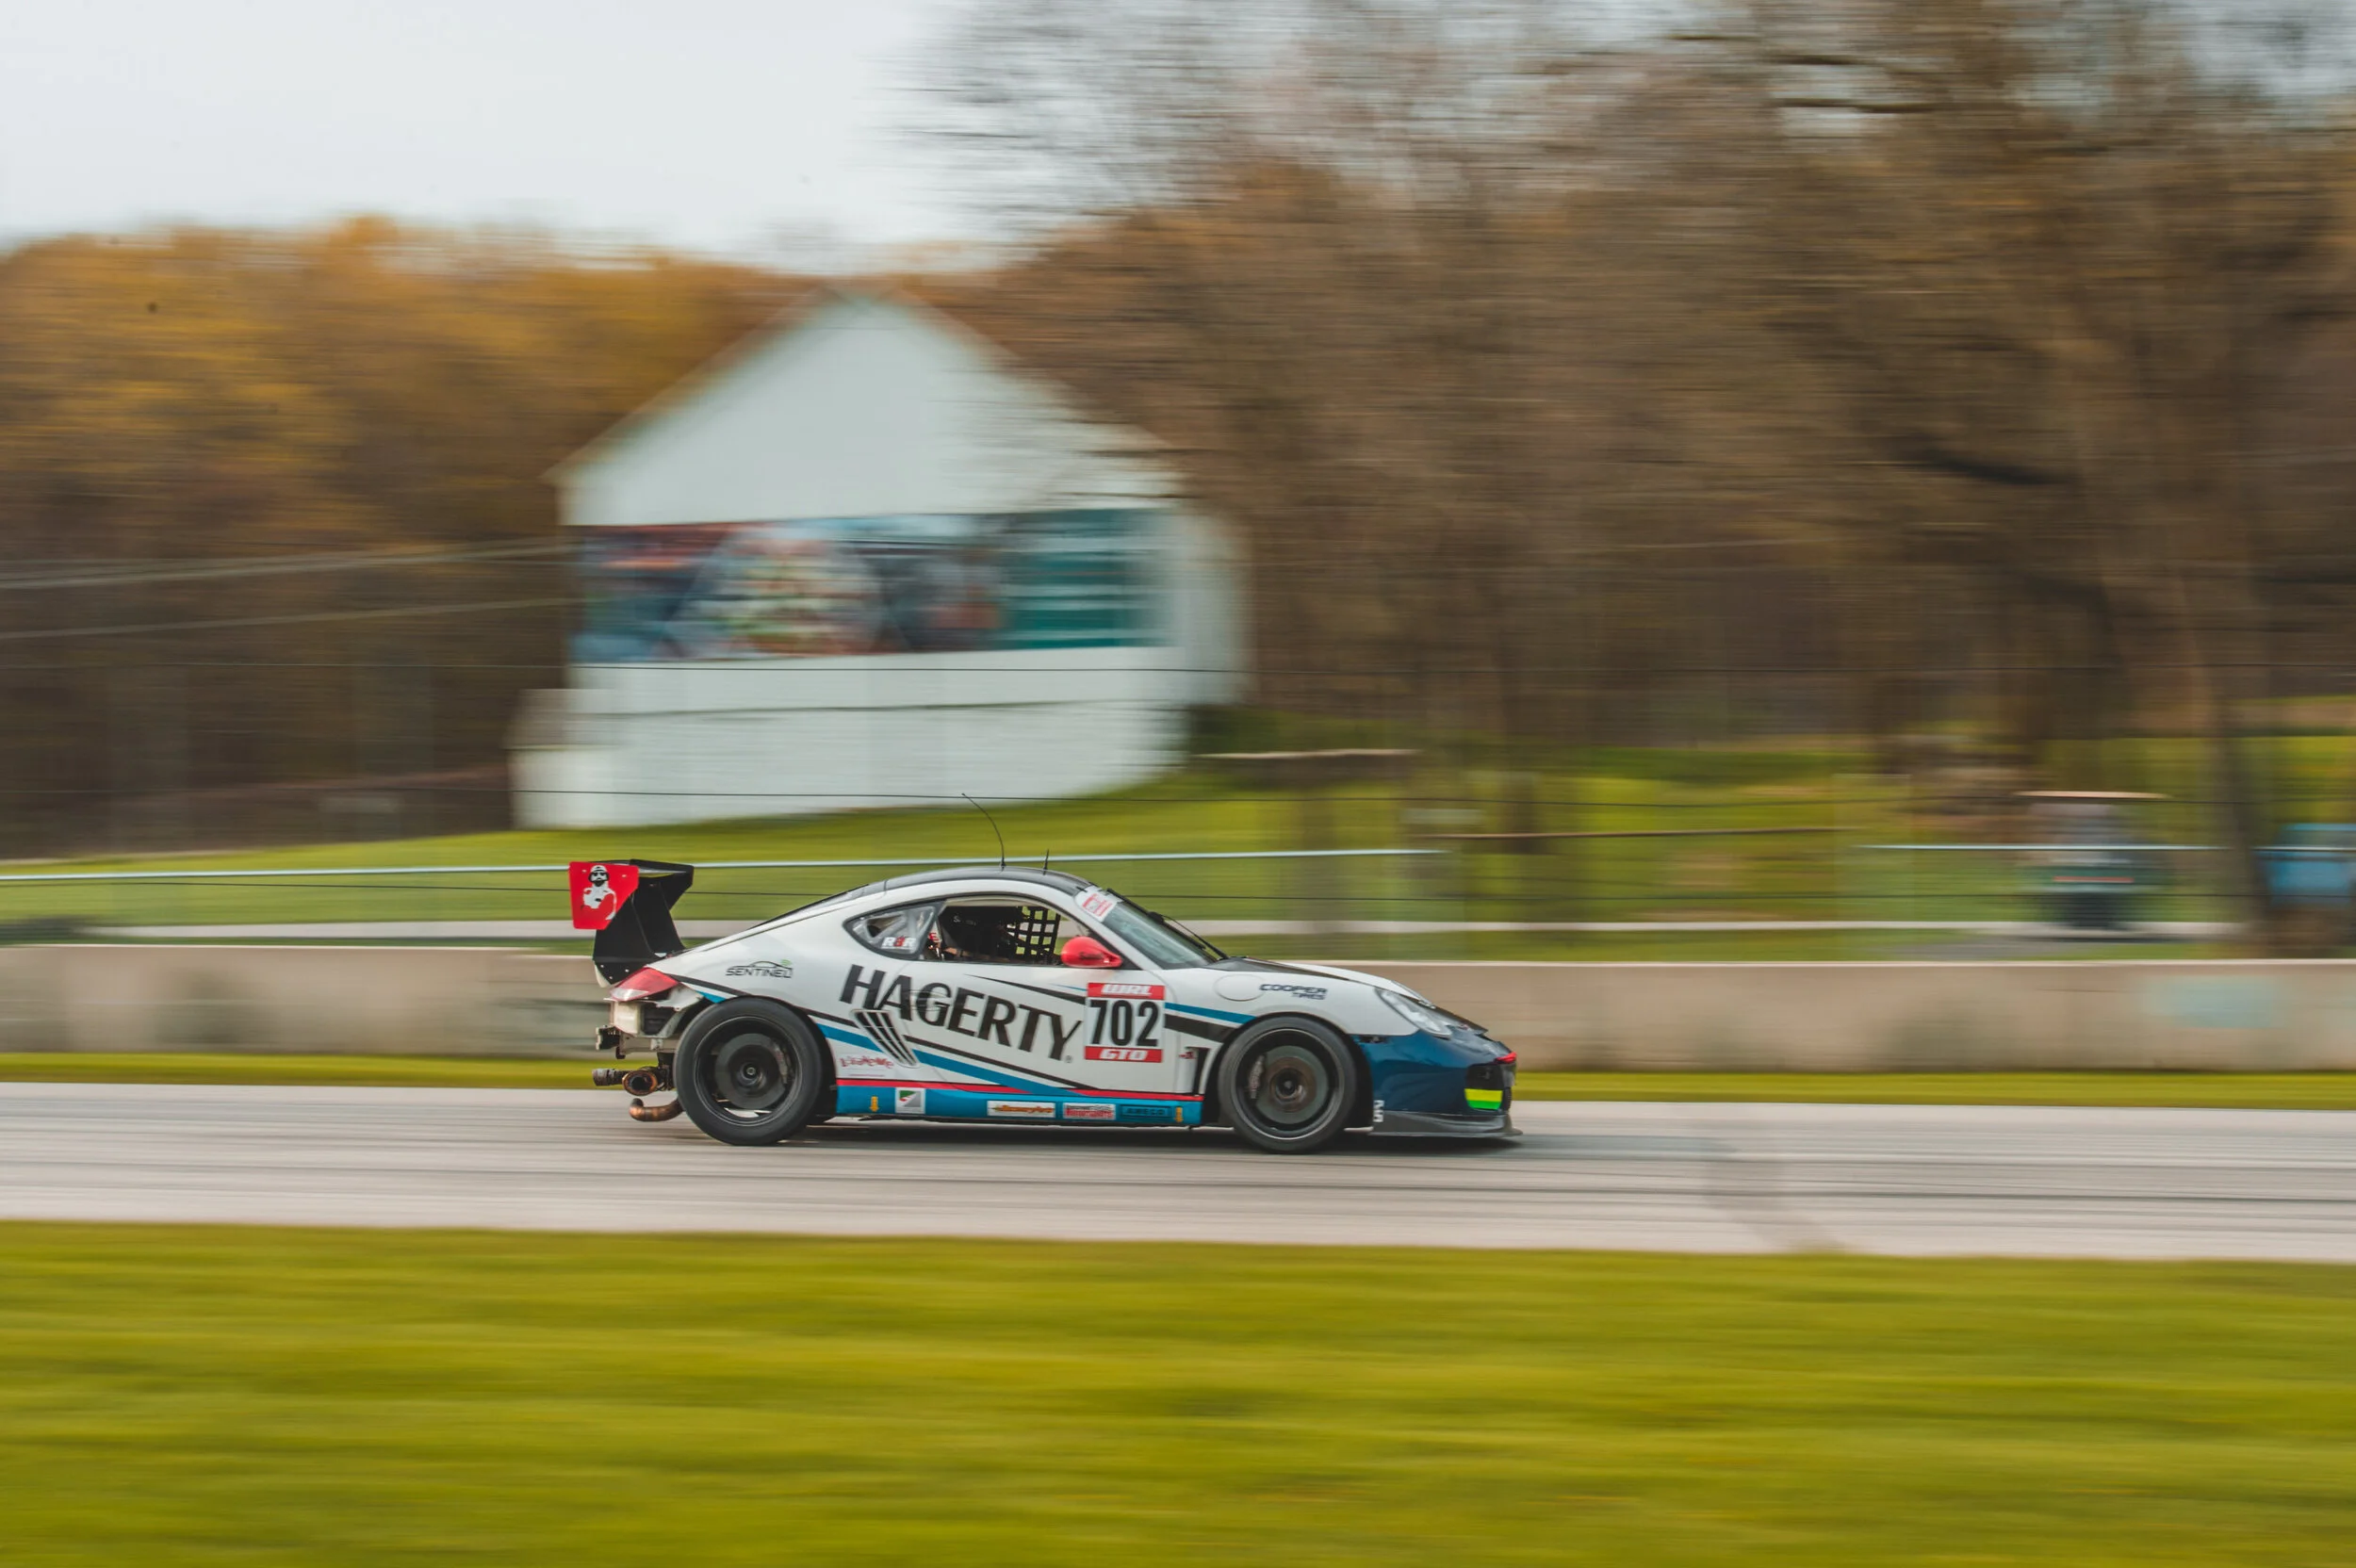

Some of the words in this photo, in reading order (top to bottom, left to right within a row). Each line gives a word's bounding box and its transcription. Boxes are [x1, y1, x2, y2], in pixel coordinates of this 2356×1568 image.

[725, 968, 793, 979] SENTINEL
[1101, 984, 1152, 995] WRL
[1259, 984, 1328, 995] COOPER
[840, 964, 1083, 1061] HAGERTY
[1089, 999, 1159, 1047] 702
[1099, 1048, 1149, 1061] GTO
